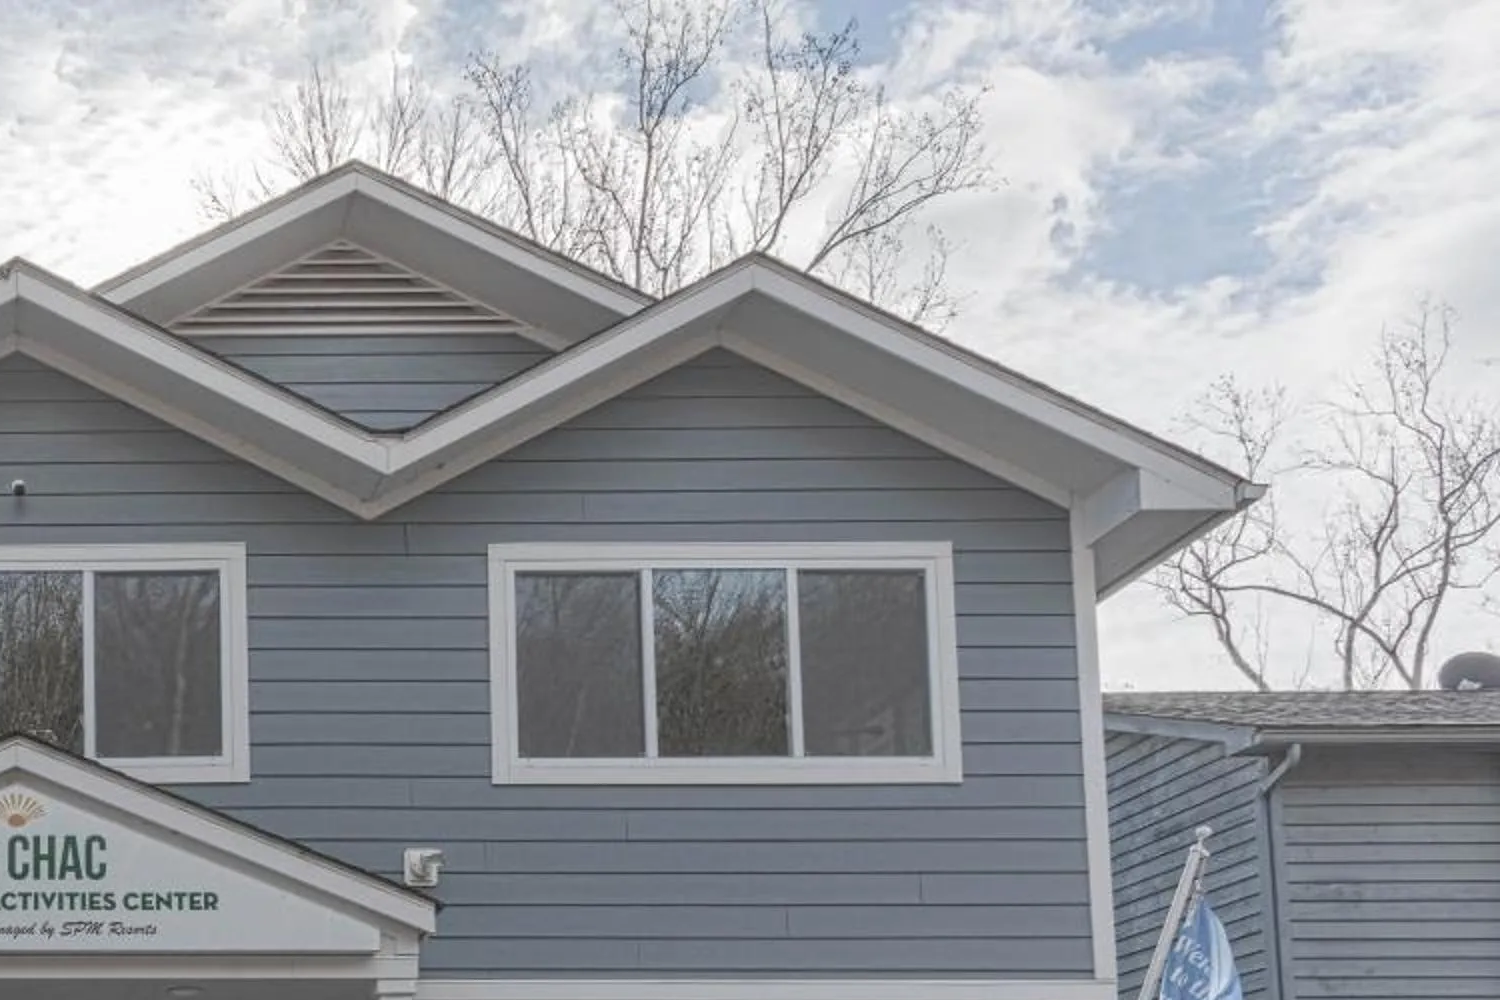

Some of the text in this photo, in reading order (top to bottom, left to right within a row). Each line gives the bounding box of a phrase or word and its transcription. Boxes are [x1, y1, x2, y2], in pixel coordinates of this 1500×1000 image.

[8, 834, 107, 881] CHAC
[122, 891, 219, 911] CENTER
[39, 922, 55, 939] by
[59, 920, 104, 936] SPM
[107, 921, 158, 936] Resorts
